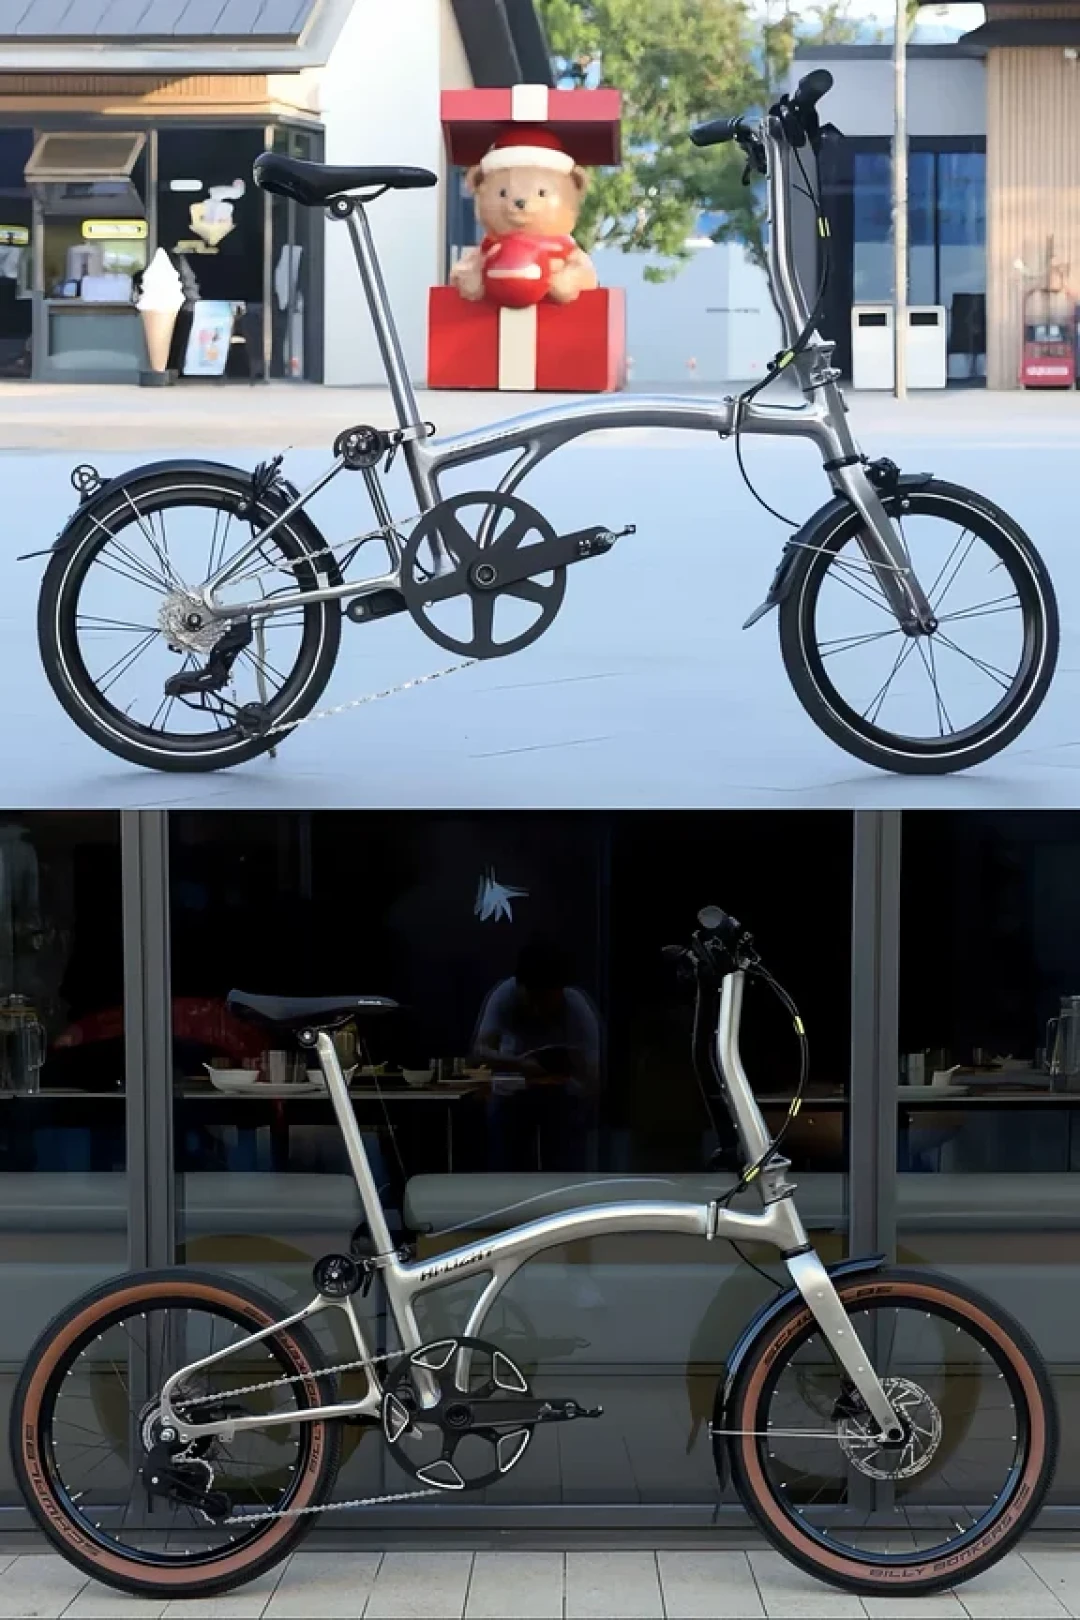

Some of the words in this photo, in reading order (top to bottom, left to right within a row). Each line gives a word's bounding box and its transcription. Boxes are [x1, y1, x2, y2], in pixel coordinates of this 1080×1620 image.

[25, 1424, 99, 1556] SCHWALBE
[867, 1567, 926, 1579] BILLY
[932, 1516, 1013, 1571] BONKERS
